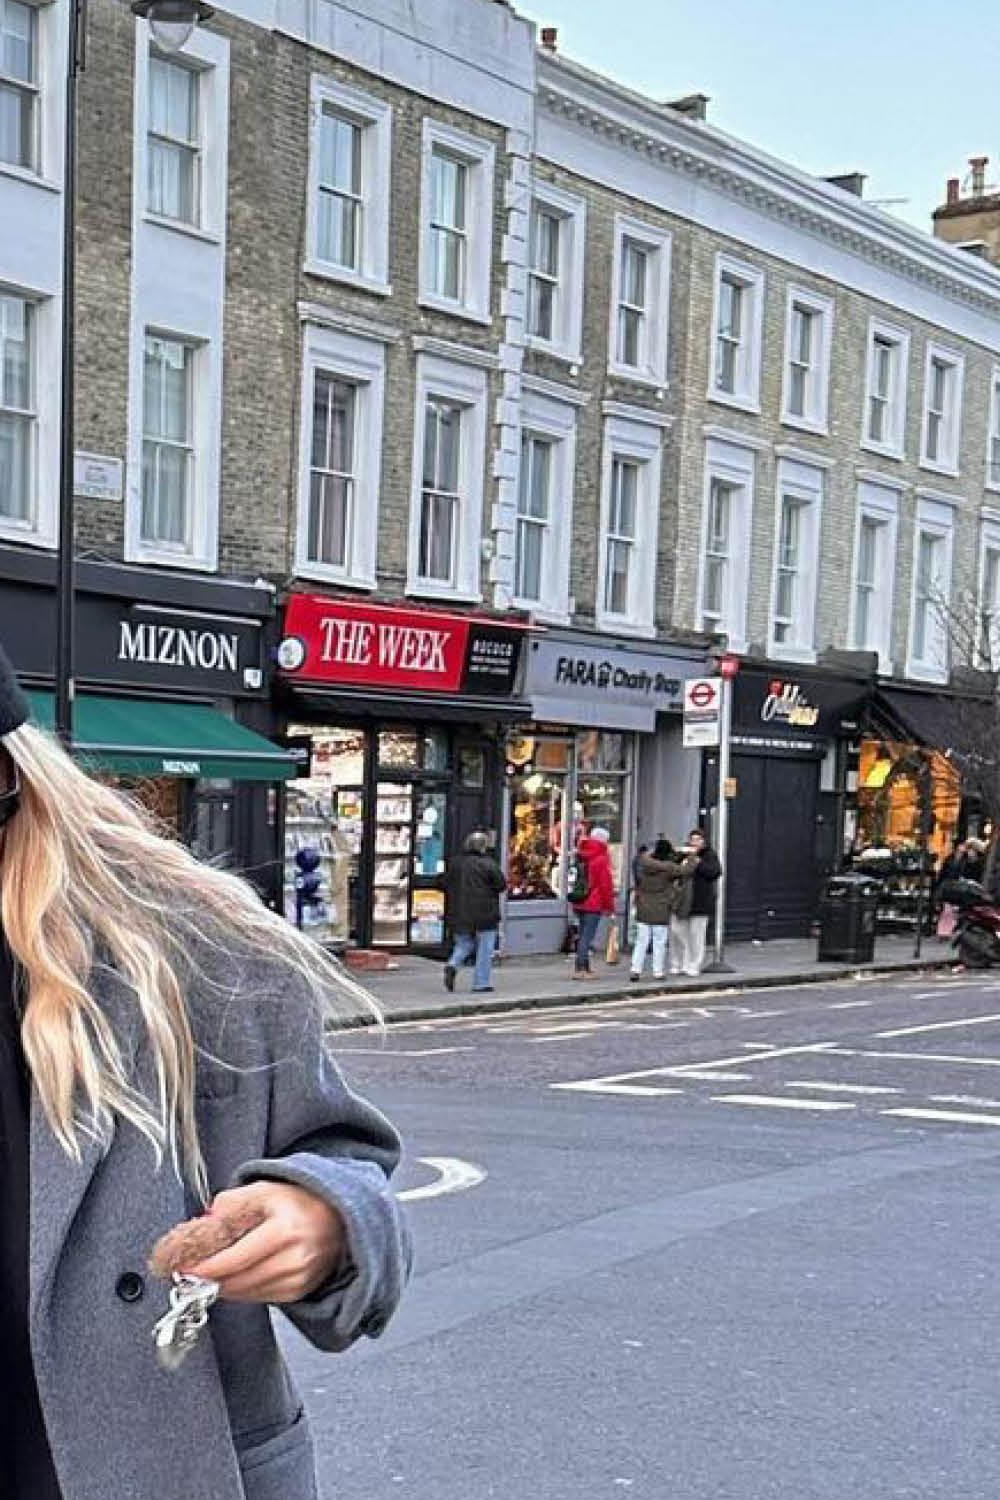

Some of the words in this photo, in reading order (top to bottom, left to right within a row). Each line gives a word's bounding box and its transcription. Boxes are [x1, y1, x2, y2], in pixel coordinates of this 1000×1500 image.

[118, 621, 239, 671] MIZNON
[320, 617, 375, 664] THE
[377, 624, 451, 673] WEEK
[556, 656, 596, 685] FARA
